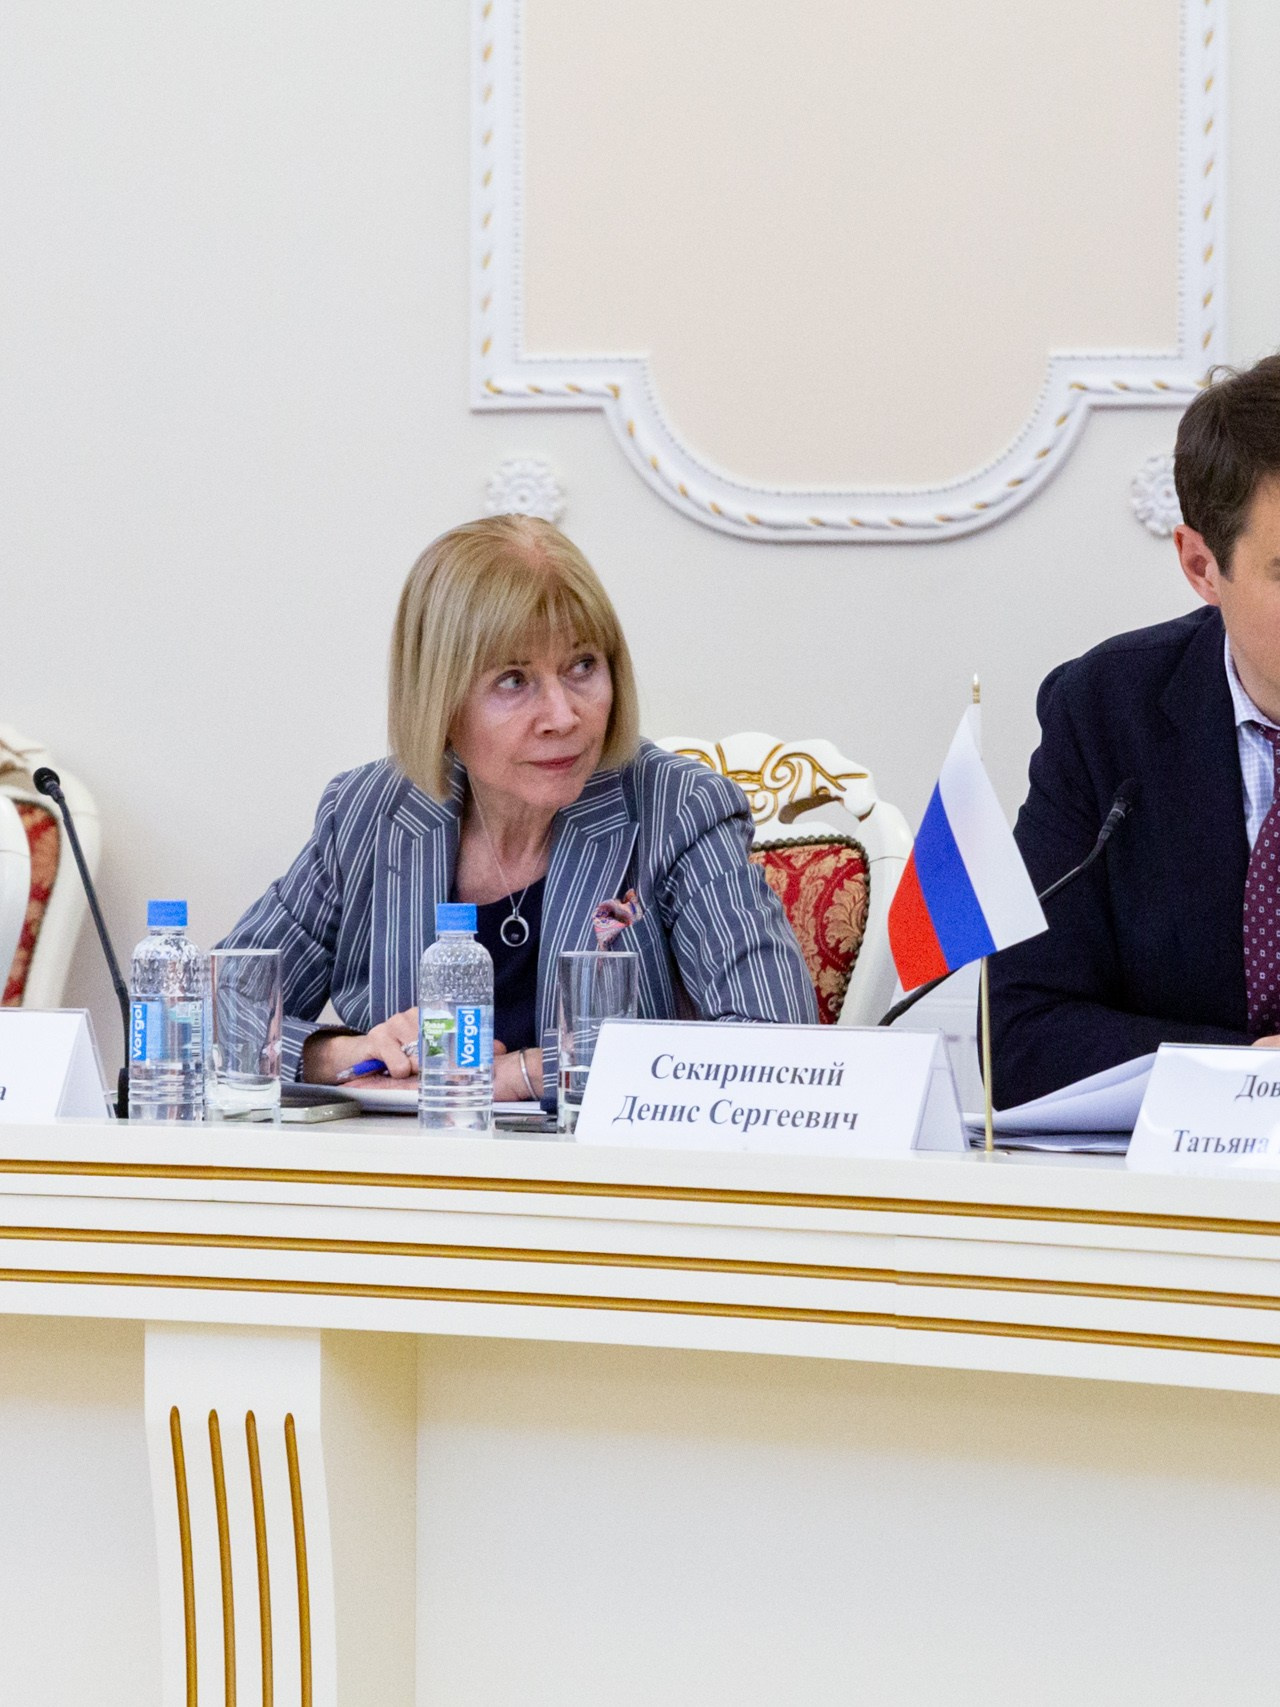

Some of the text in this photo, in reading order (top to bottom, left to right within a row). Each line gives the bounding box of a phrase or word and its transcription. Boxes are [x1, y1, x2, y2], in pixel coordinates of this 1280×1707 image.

[132, 1003, 145, 1059] Vorgol
[460, 1009, 479, 1066] Vorgol
[650, 1053, 846, 1091] Секиринский
[612, 1096, 860, 1134] Денис Сергеевич
[1173, 1129, 1270, 1155] Татьяна
